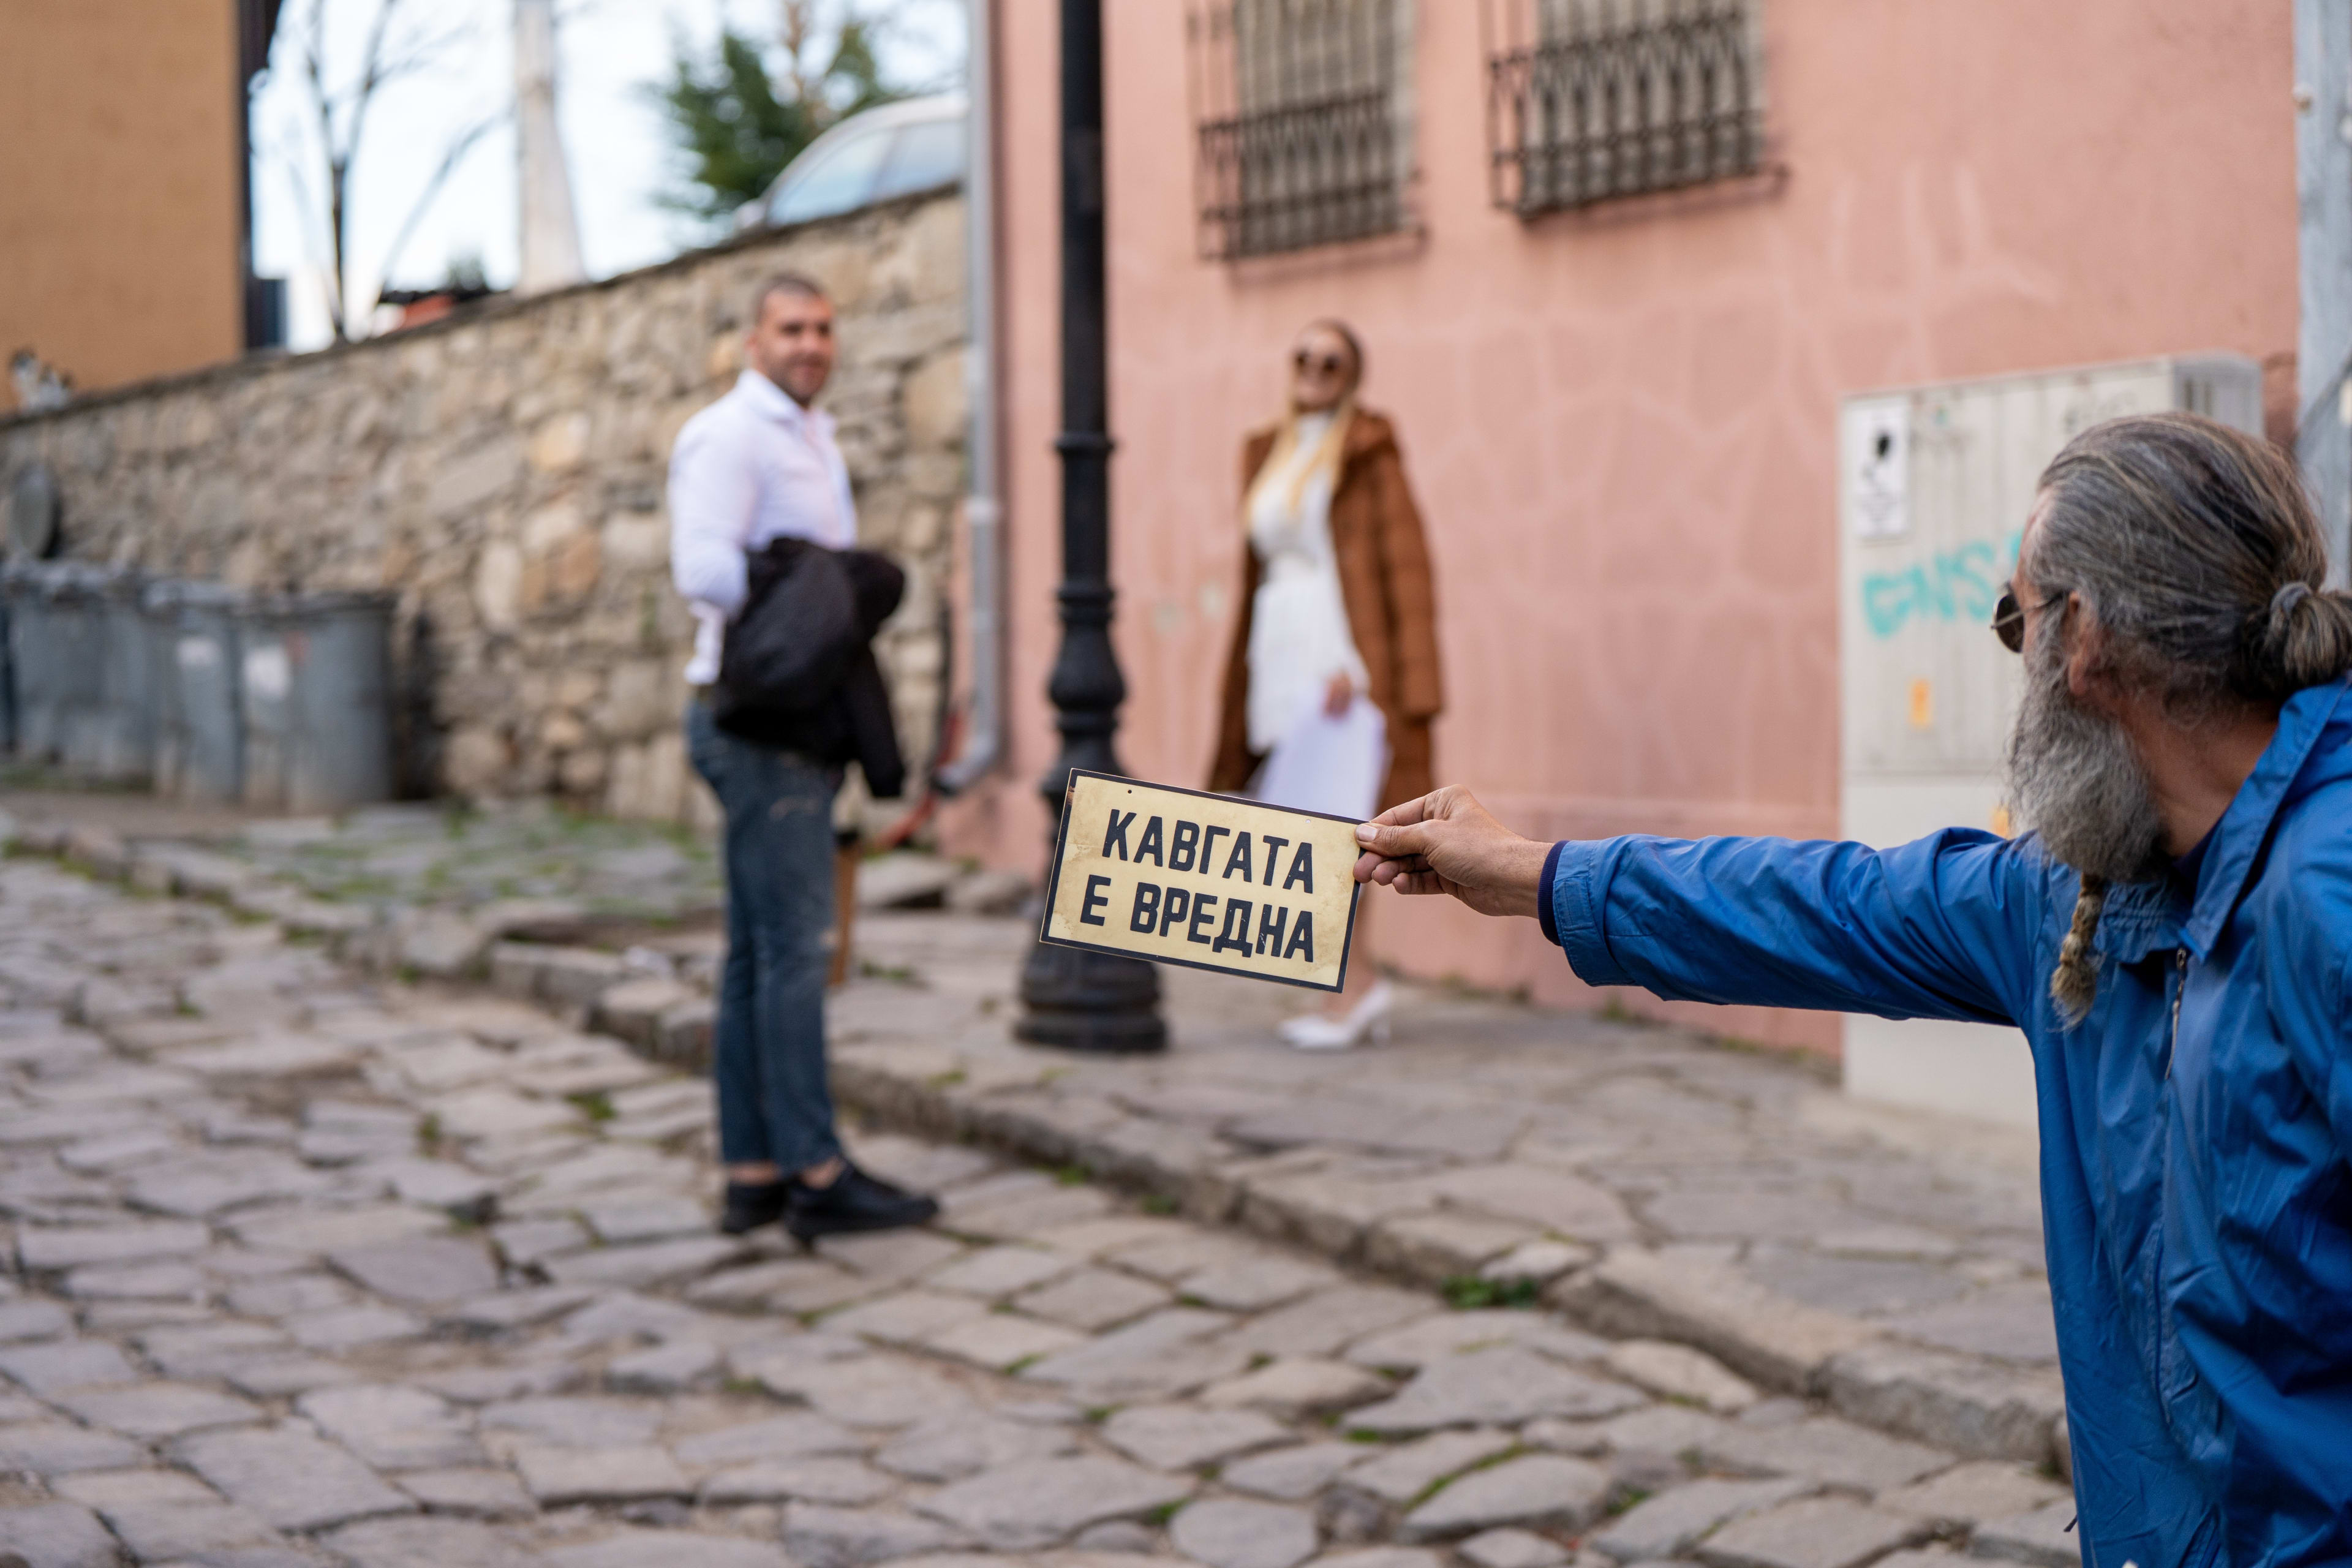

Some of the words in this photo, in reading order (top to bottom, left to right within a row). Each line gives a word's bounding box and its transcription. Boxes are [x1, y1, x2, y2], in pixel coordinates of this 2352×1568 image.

[1102, 809, 1313, 894] КАВГАТА
[1080, 874, 1112, 926] Е
[1129, 882, 1313, 963] ВРЕДНА
